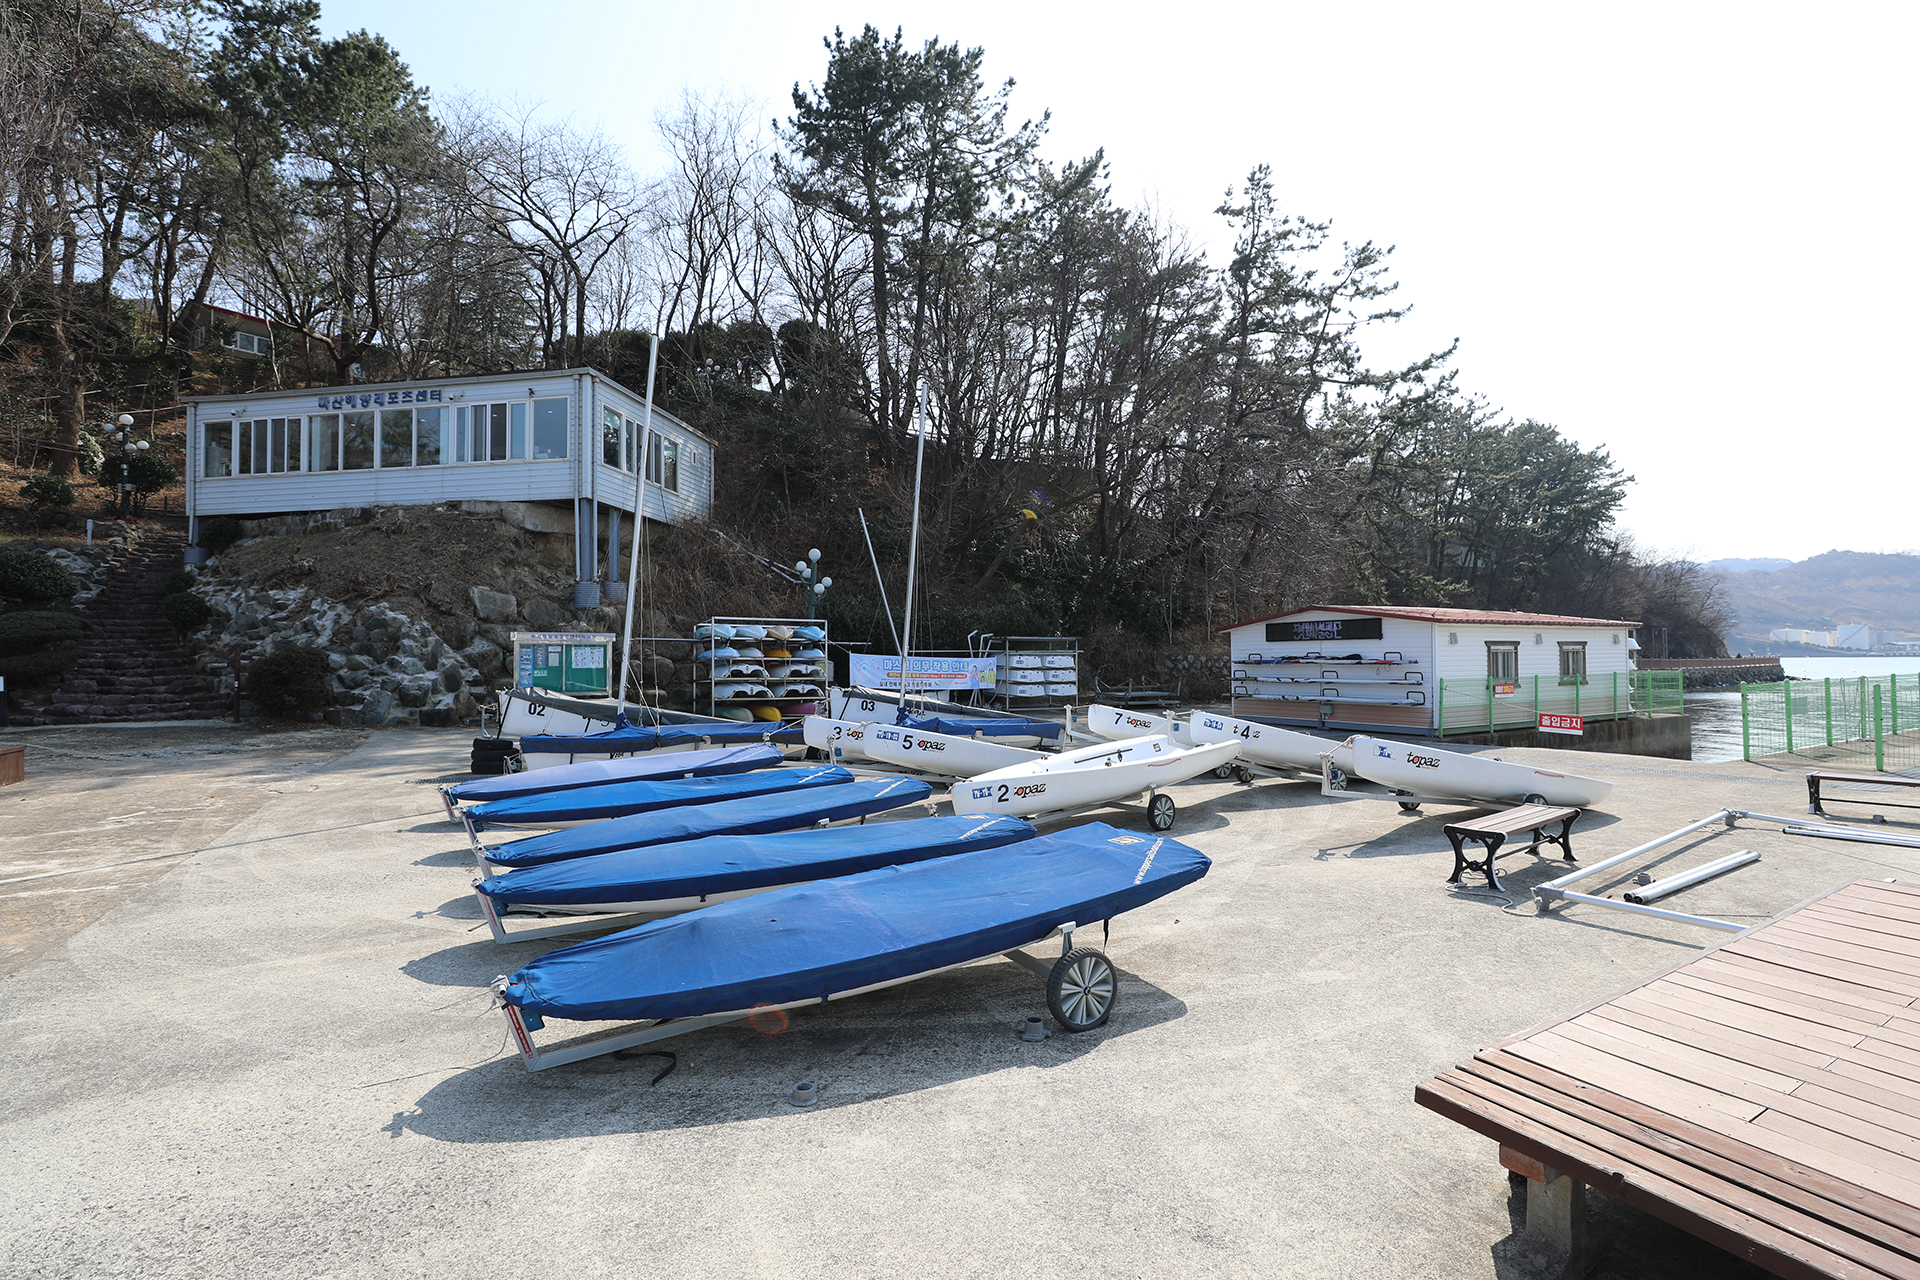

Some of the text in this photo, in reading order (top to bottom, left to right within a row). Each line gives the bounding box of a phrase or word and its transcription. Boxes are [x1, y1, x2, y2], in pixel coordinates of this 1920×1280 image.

[318, 389, 442, 410] 마산해양레포츠센터
[913, 659, 931, 672] 의무
[932, 660, 949, 672] 착용
[952, 660, 969, 672] 안내
[528, 702, 546, 717] 02
[860, 700, 876, 712] 03
[1114, 712, 1152, 730] 7 topaz
[1541, 715, 1581, 729] 출입금지
[833, 726, 842, 740] 3
[1240, 725, 1251, 740] 4
[902, 734, 913, 750] 5
[917, 738, 947, 752] opaz
[1406, 751, 1441, 768] topaz
[997, 784, 1010, 803] 2
